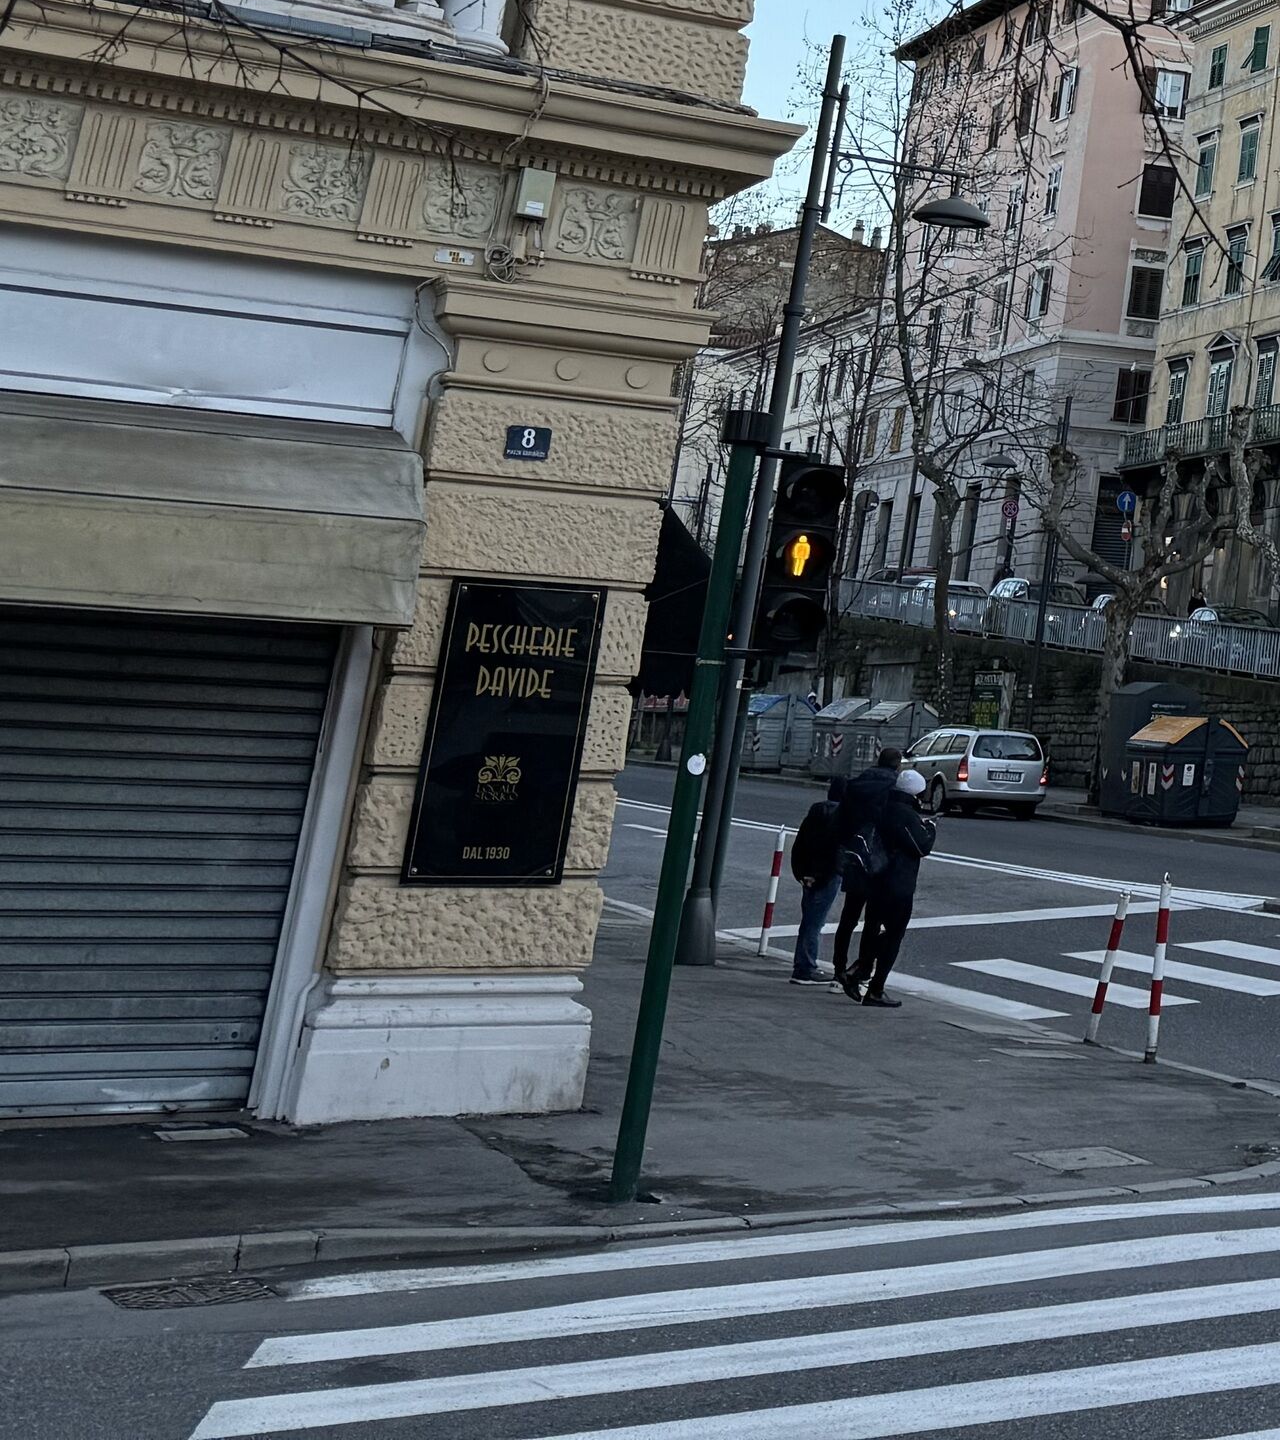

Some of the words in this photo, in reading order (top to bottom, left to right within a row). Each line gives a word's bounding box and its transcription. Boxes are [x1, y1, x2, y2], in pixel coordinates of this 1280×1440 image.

[521, 428, 536, 449] 8
[465, 622, 578, 658] PESCHERIE
[476, 665, 554, 699] DAVIDE
[462, 846, 483, 859] DAL
[485, 846, 511, 859] 1930
